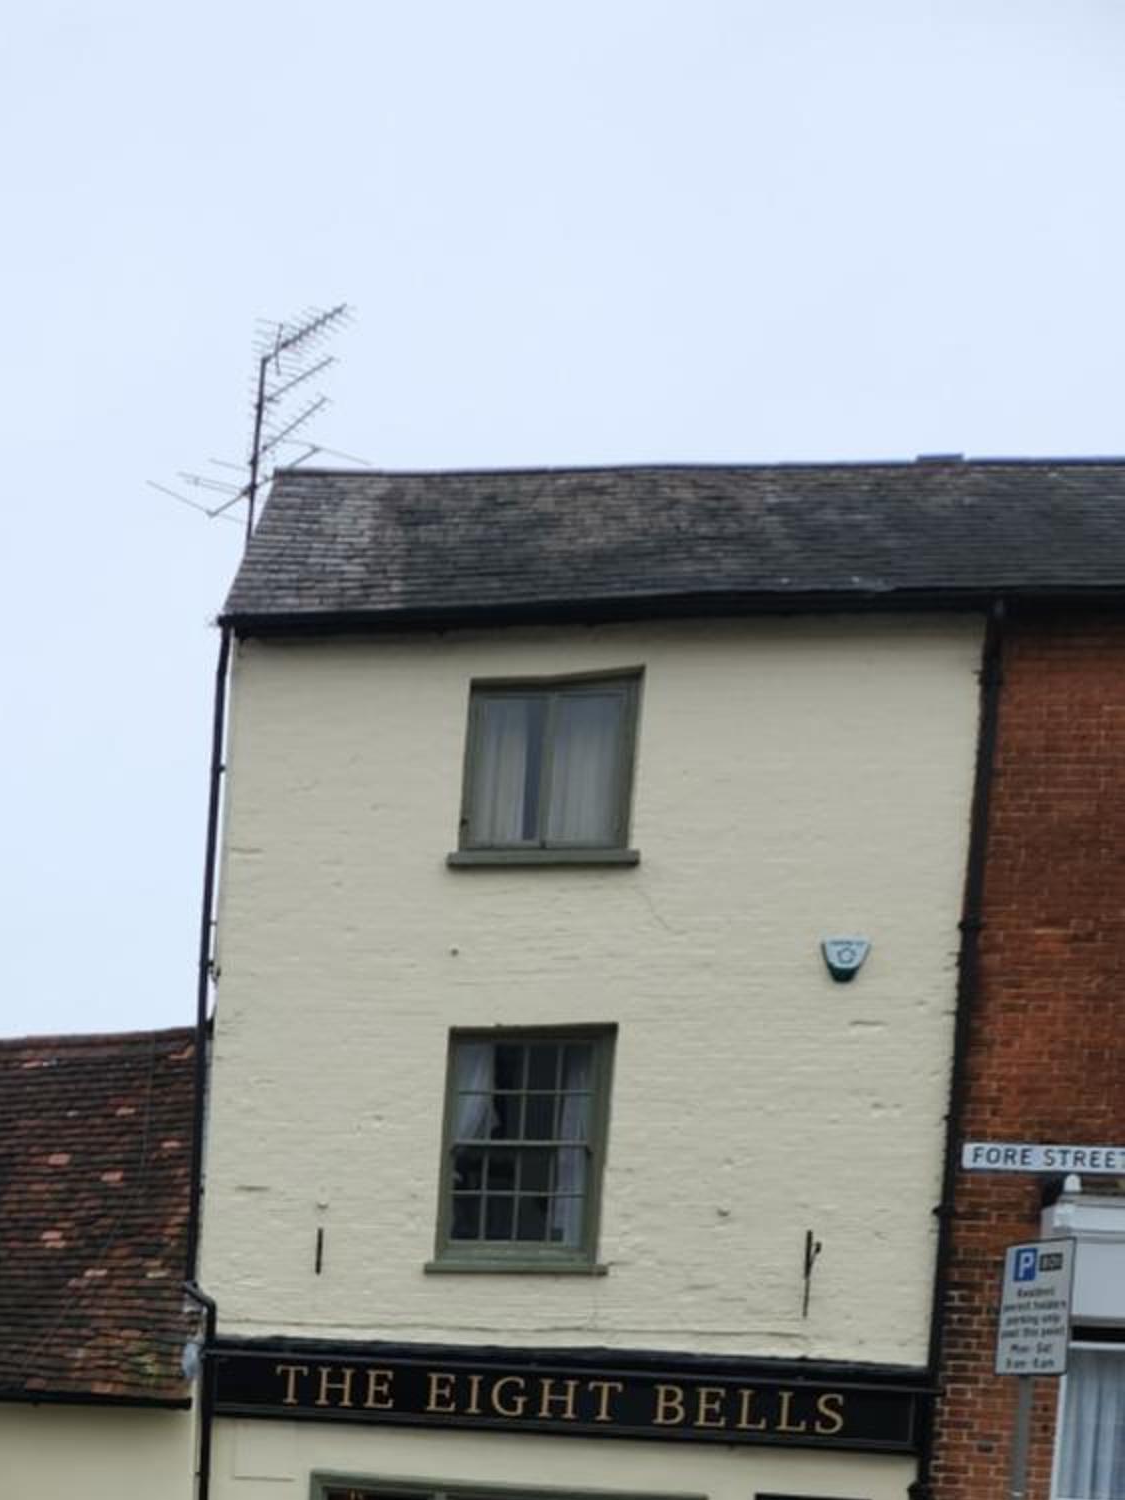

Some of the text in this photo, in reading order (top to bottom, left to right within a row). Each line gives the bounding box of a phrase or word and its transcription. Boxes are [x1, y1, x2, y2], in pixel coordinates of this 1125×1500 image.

[972, 1146, 1033, 1166] FORE
[276, 1365, 845, 1434] THE EIGHT BELLS
